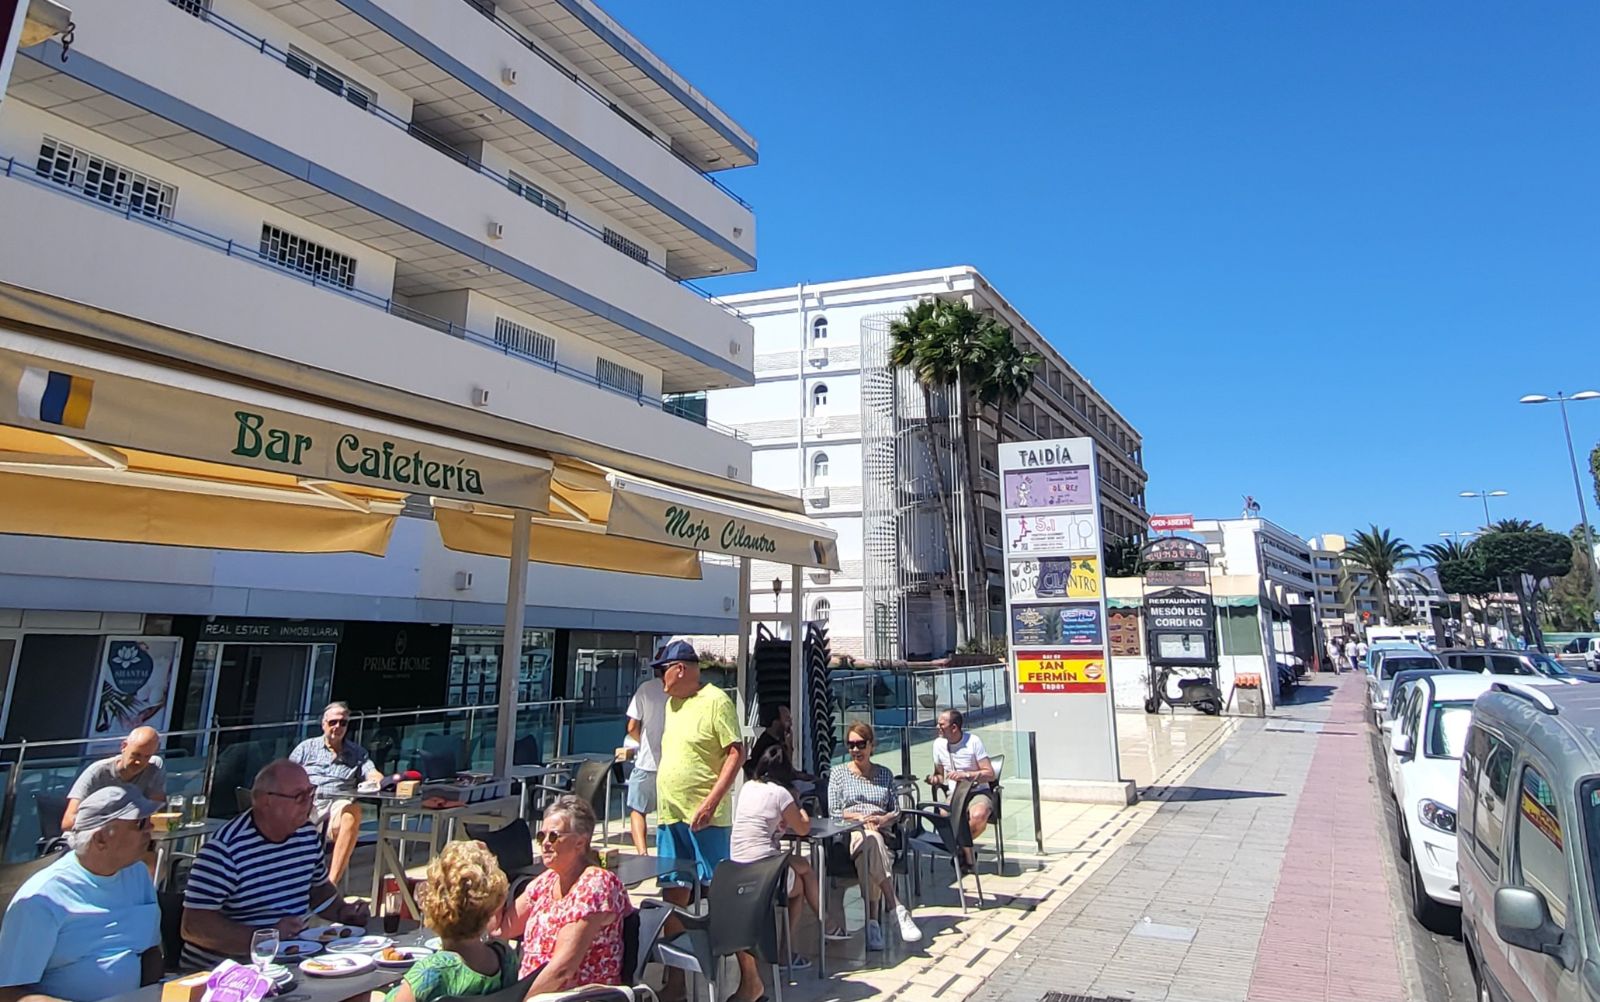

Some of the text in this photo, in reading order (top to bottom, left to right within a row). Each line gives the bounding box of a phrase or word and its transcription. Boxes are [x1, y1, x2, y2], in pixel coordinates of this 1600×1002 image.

[231, 410, 485, 495] Bar Cafetería
[665, 506, 777, 553] Mojo Cilantro
[1012, 572, 1097, 595] MOJO CILANTRO
[1150, 605, 1207, 616] MESÓN DEL
[1155, 618, 1204, 627] CORDERO
[205, 624, 339, 637] REAL ESTATE INMOBILIARIA
[362, 655, 432, 672] PRIME HOME
[1039, 661, 1064, 670] SAN
[1027, 670, 1078, 681] FERMÍN
